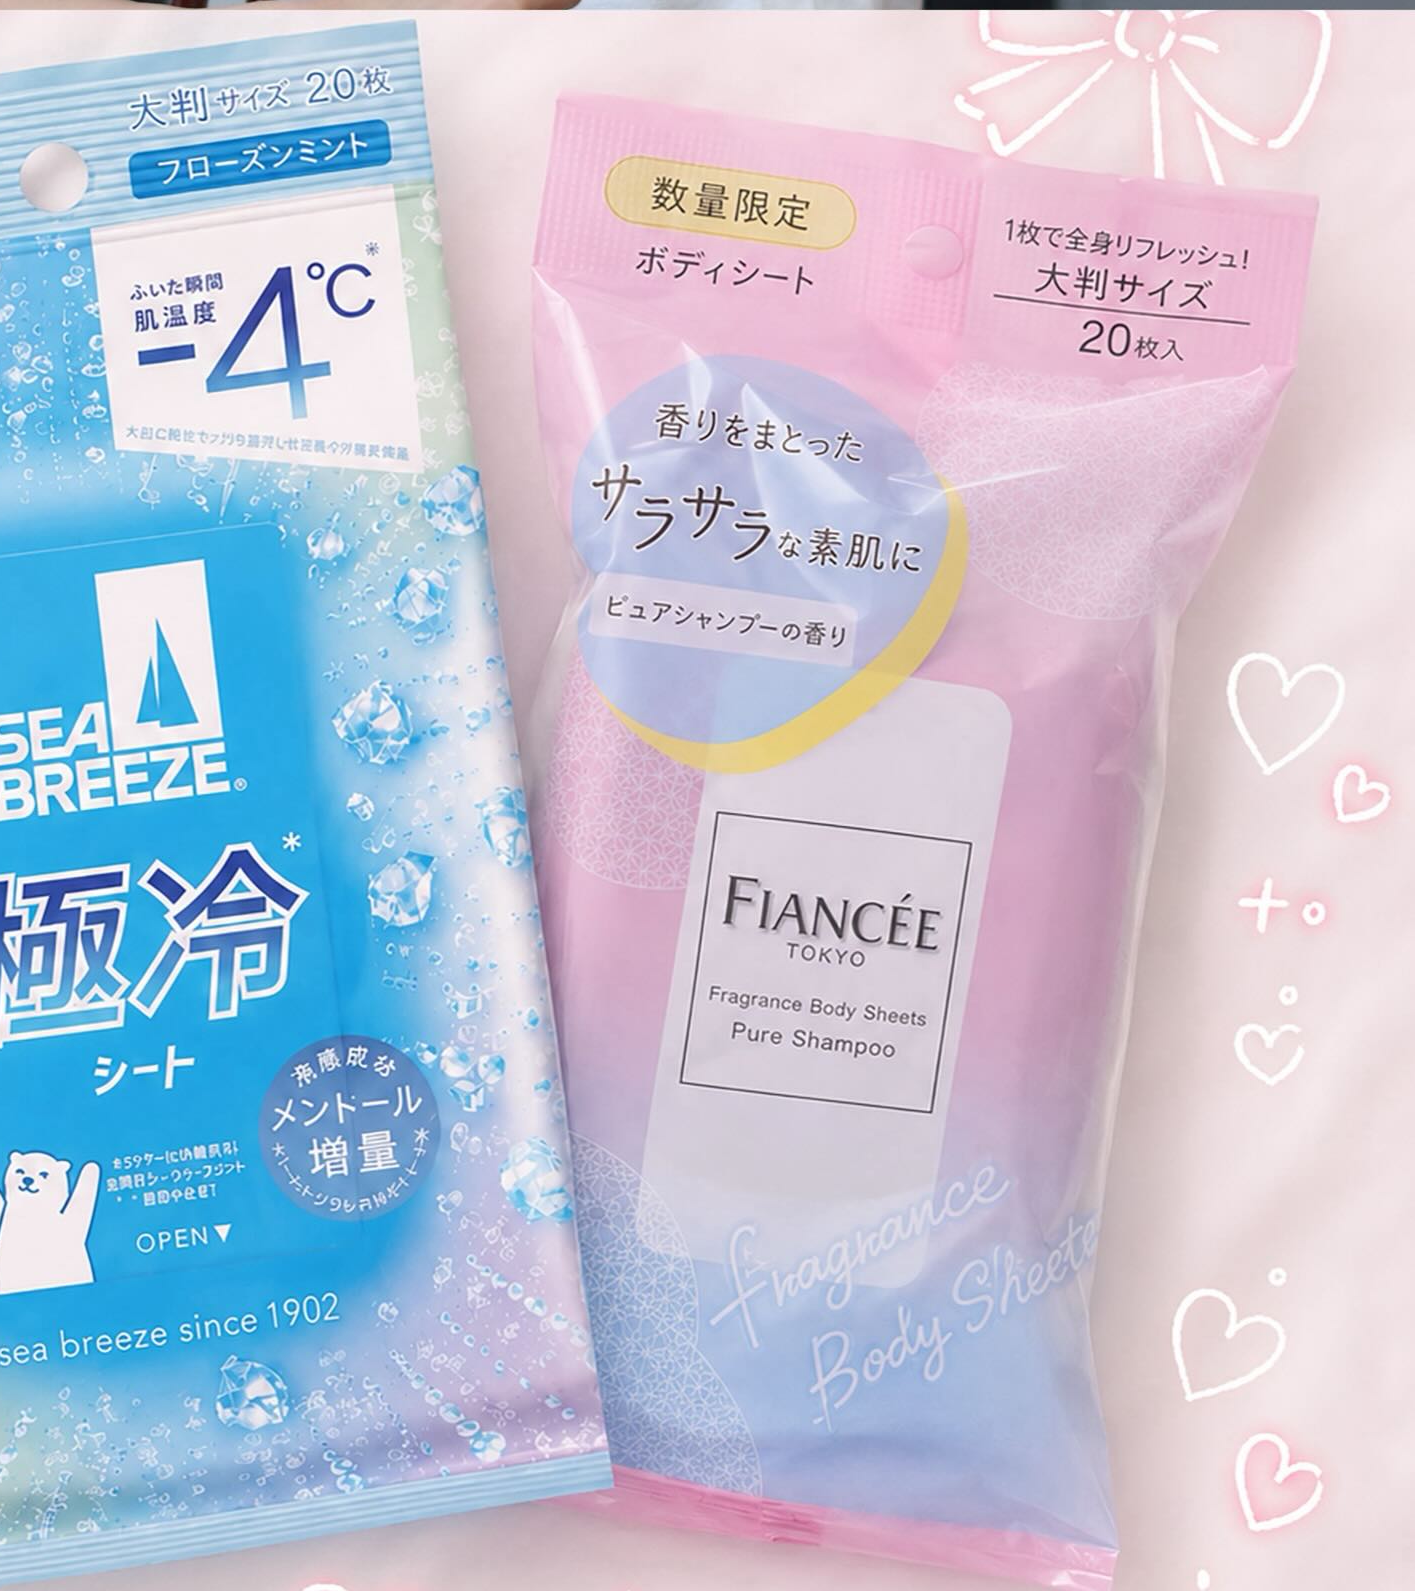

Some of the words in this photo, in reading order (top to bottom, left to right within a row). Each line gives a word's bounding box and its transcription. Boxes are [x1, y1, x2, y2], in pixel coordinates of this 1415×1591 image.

[156, 131, 369, 185] フローズンミント
[650, 175, 812, 232] 数量限定
[1004, 218, 1250, 271] 1枚で全身リフレッシュ!
[130, 272, 225, 301] ふいた瞬間
[635, 245, 815, 296] ボディシート
[1034, 262, 1214, 310] 大判サイズ
[134, 301, 218, 333] 肌温度
[1078, 319, 1185, 361] 20枚入
[654, 402, 864, 463] 香りをまとった
[590, 463, 924, 573] サラサラな素肌に
[606, 594, 848, 649] ピュアシャンプーの香り
[787, 942, 866, 968] TOKYO
[708, 985, 803, 1012] Fragrance
[810, 998, 858, 1022] Body
[863, 1004, 928, 1028] Sheets
[731, 1021, 783, 1046] Pure
[792, 1029, 897, 1059] Shampoo
[93, 1045, 196, 1097] シート
[271, 1084, 423, 1132] メントール
[308, 1129, 401, 1179] 増量
[135, 1226, 209, 1254] OPEN
[709, 1165, 1011, 1349] Fragrance
[59, 1329, 168, 1360] breeze
[179, 1313, 258, 1342] since
[267, 1291, 340, 1329] 1902
[809, 1305, 953, 1432] Body
